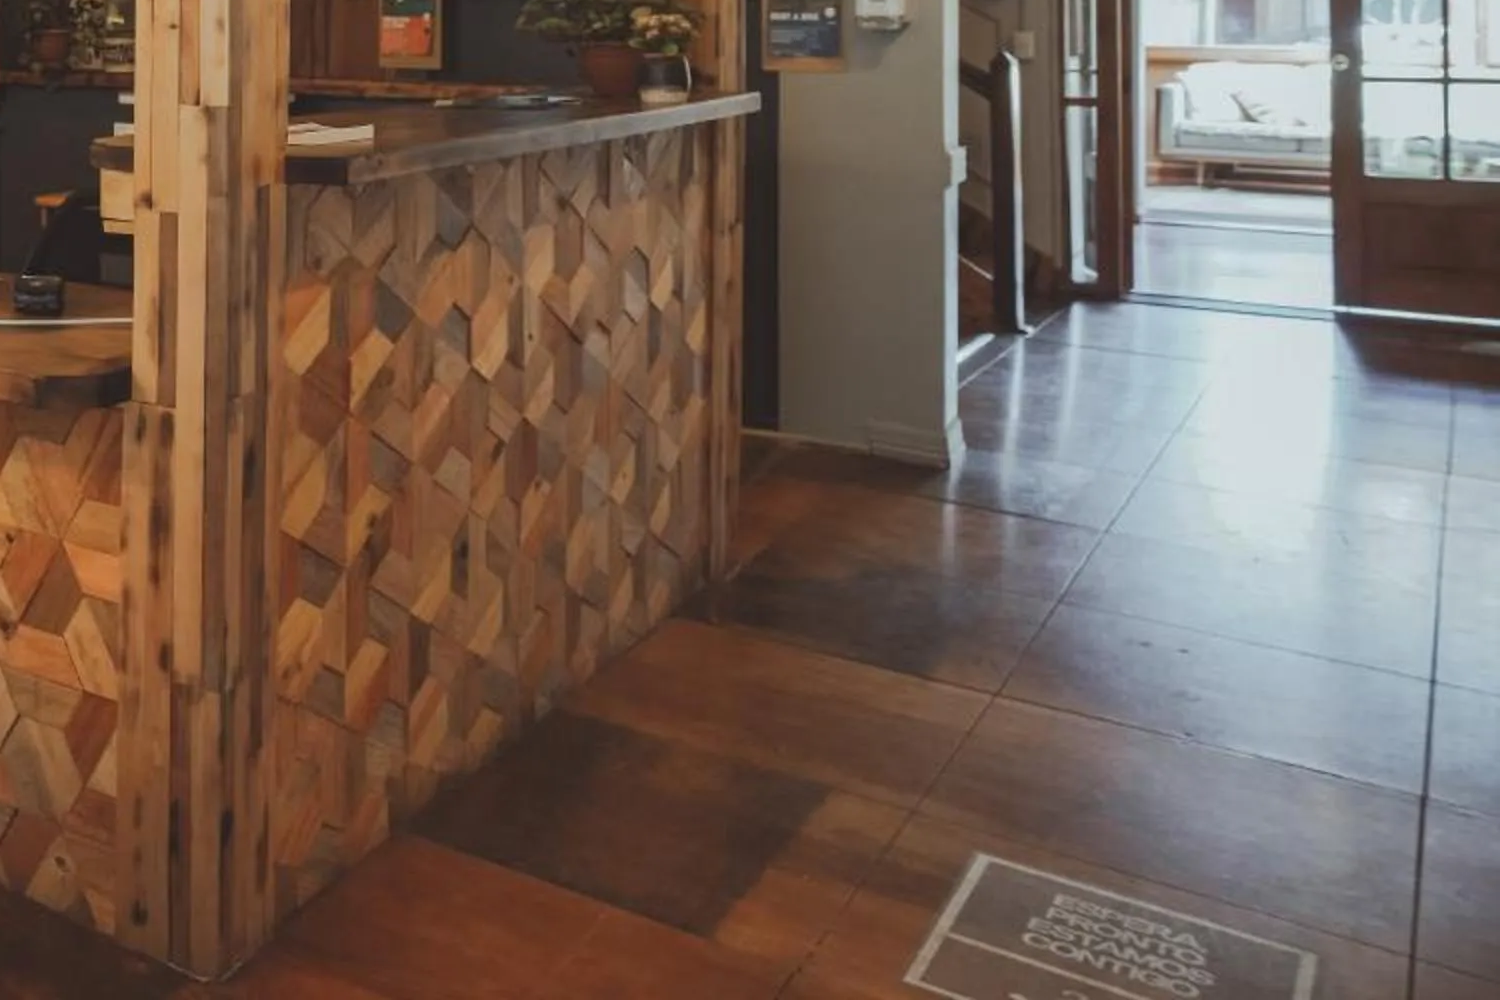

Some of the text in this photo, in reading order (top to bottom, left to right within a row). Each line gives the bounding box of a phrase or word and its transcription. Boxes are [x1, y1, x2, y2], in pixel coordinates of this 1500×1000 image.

[1021, 932, 1200, 998] CONTIGO
[1027, 917, 1216, 986] ESTAMOS
[1046, 906, 1205, 966] PRONTO
